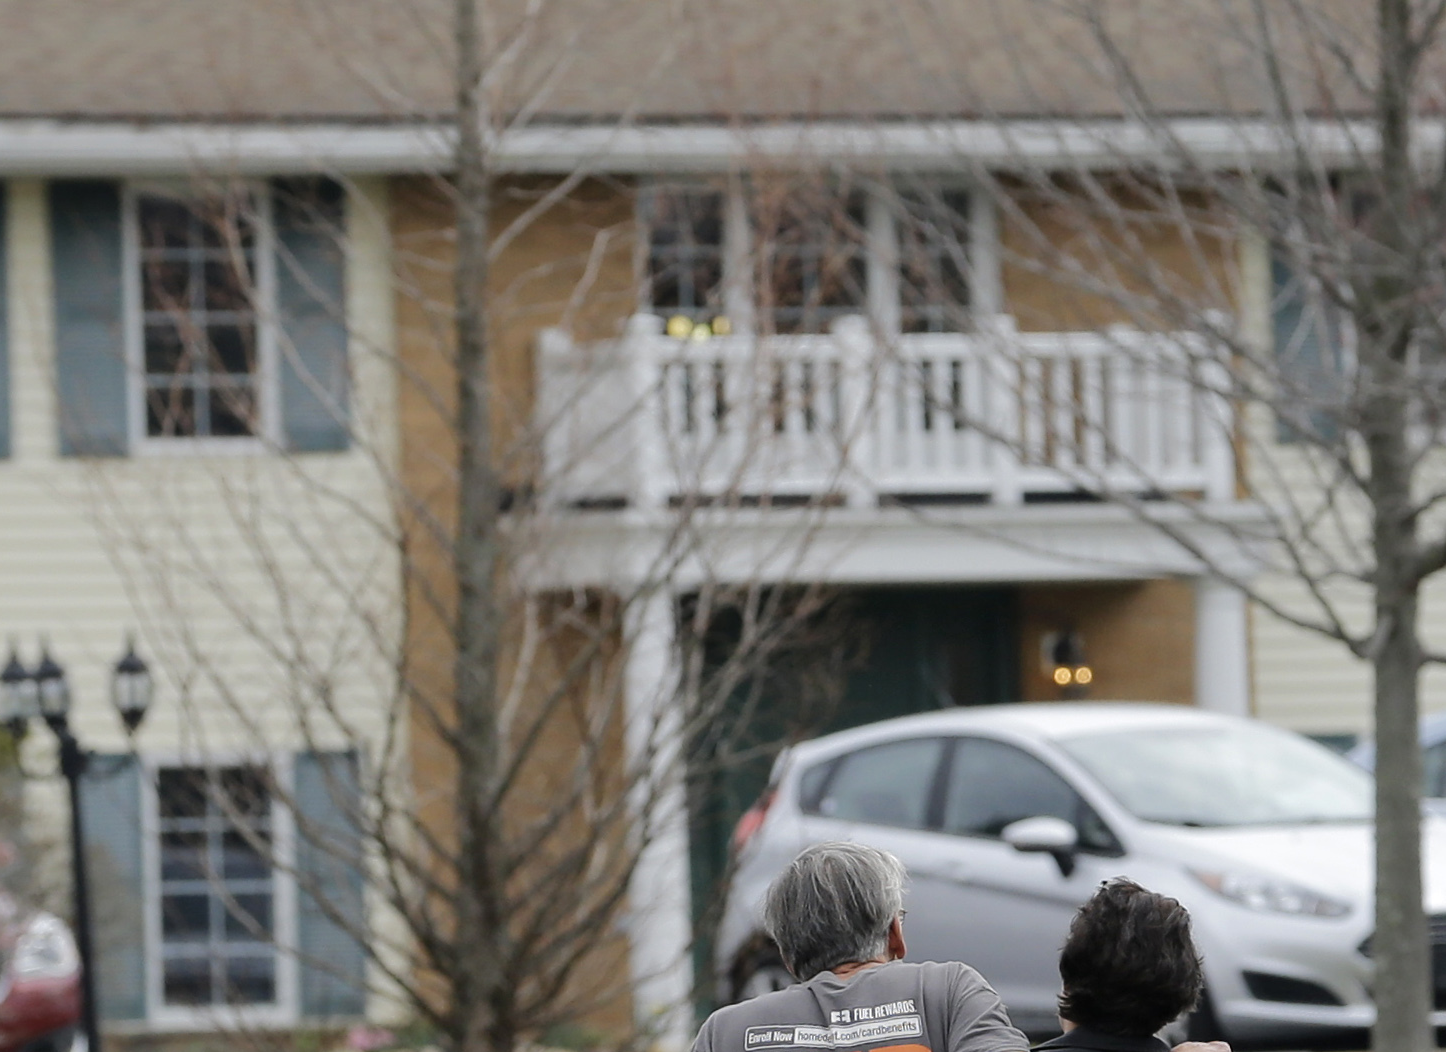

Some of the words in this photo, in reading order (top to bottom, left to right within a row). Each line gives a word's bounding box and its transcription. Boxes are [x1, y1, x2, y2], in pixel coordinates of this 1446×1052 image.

[854, 1007, 874, 1021] FUEL
[748, 1031, 772, 1044] Enroll
[773, 1031, 793, 1042] Now
